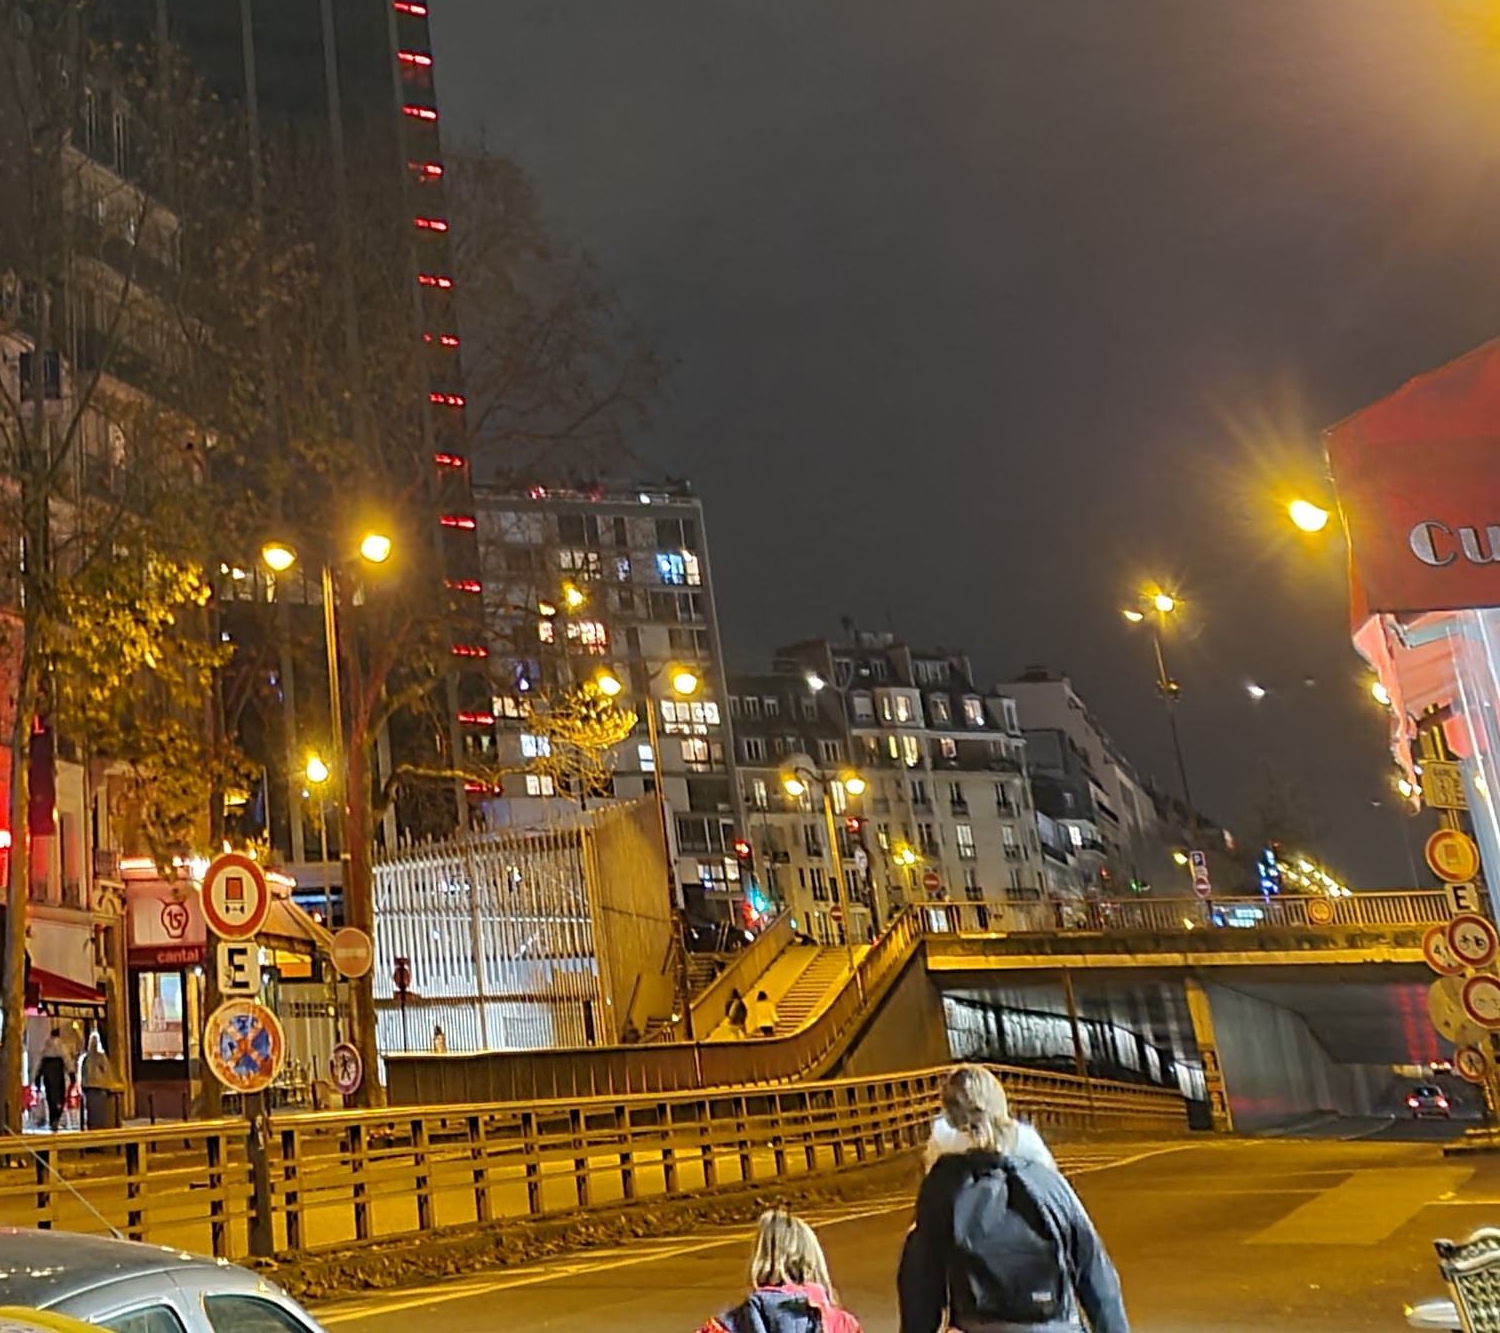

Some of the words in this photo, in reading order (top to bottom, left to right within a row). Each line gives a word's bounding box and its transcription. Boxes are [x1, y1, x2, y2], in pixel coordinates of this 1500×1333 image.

[1452, 885, 1471, 910] E
[157, 948, 199, 964] cantal
[227, 947, 250, 989] E
